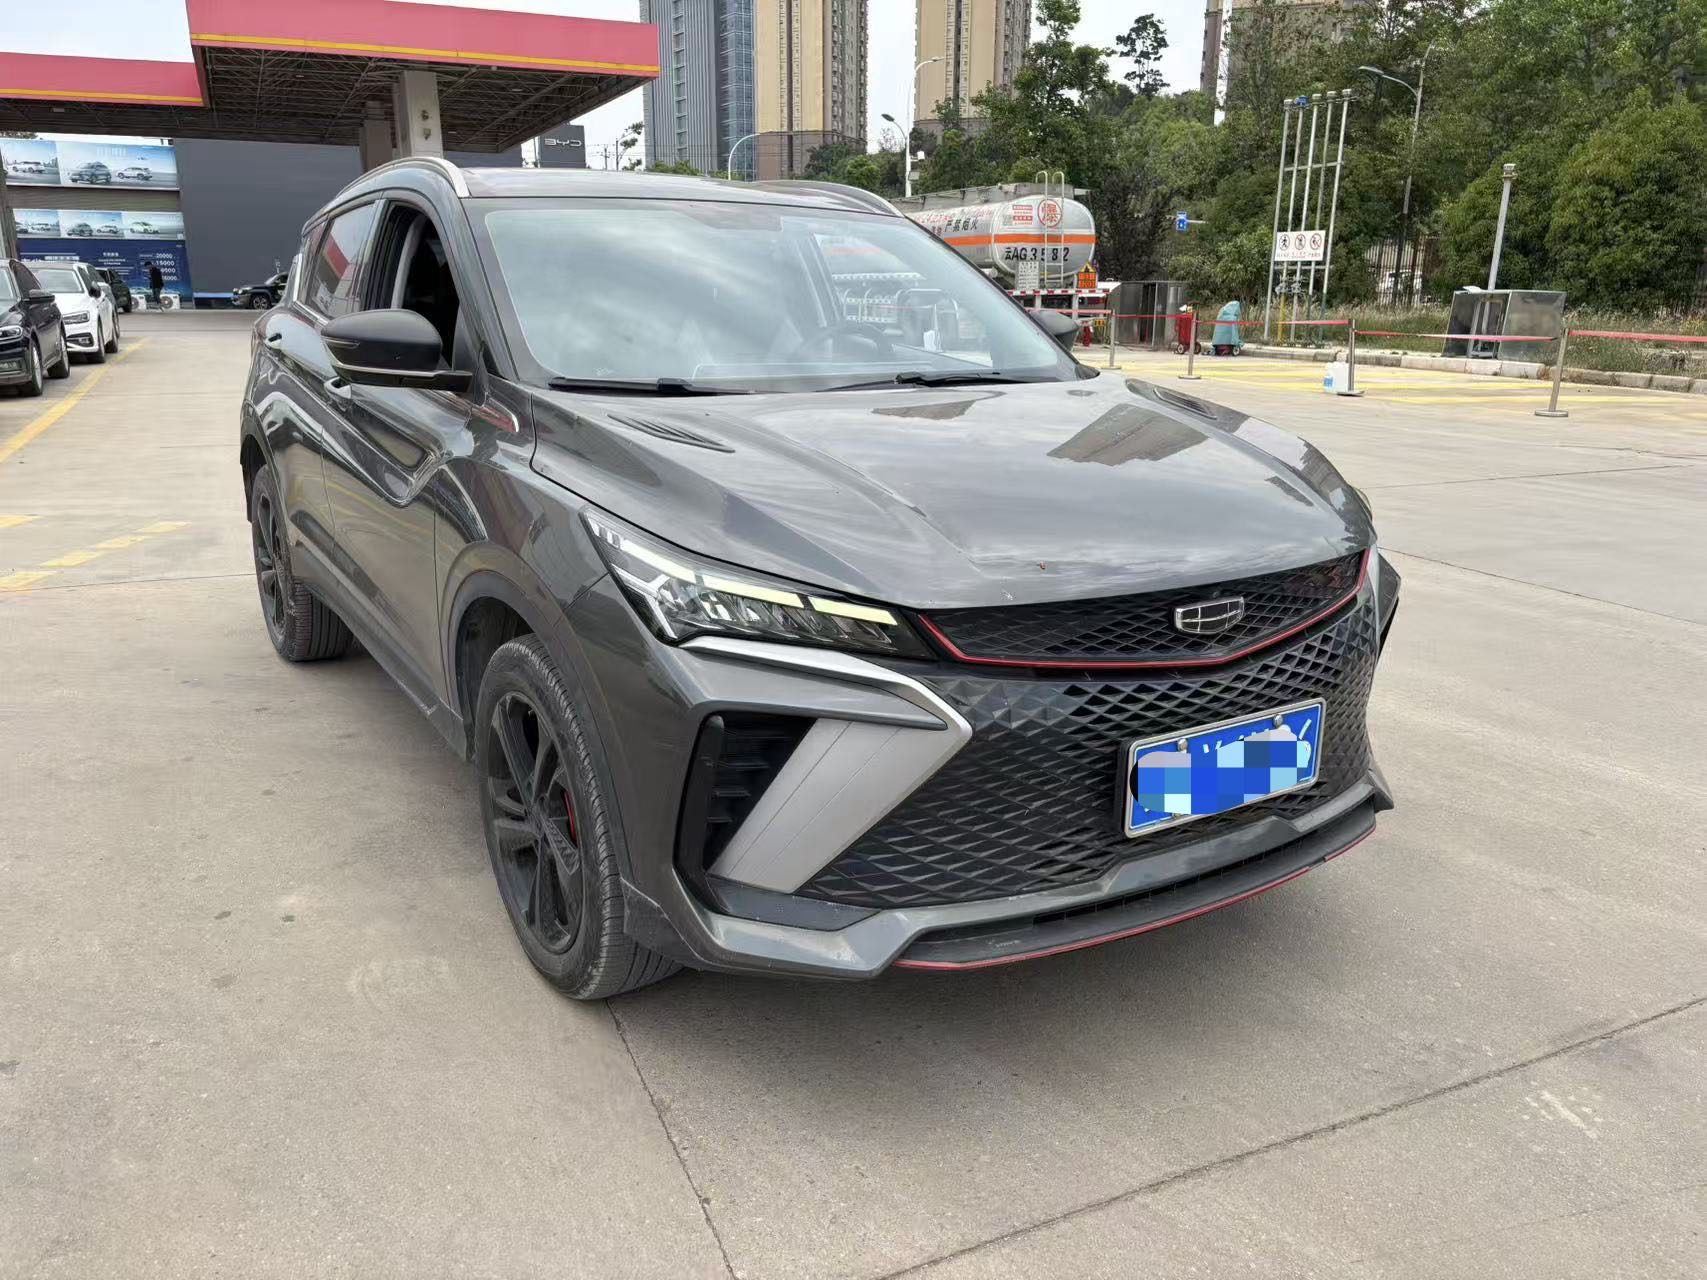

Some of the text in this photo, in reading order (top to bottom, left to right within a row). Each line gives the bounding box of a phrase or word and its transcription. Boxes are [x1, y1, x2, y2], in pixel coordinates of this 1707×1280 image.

[544, 138, 582, 147] BYD
[945, 218, 979, 233] 严禁烟火
[1004, 247, 1070, 261] 云AG3582
